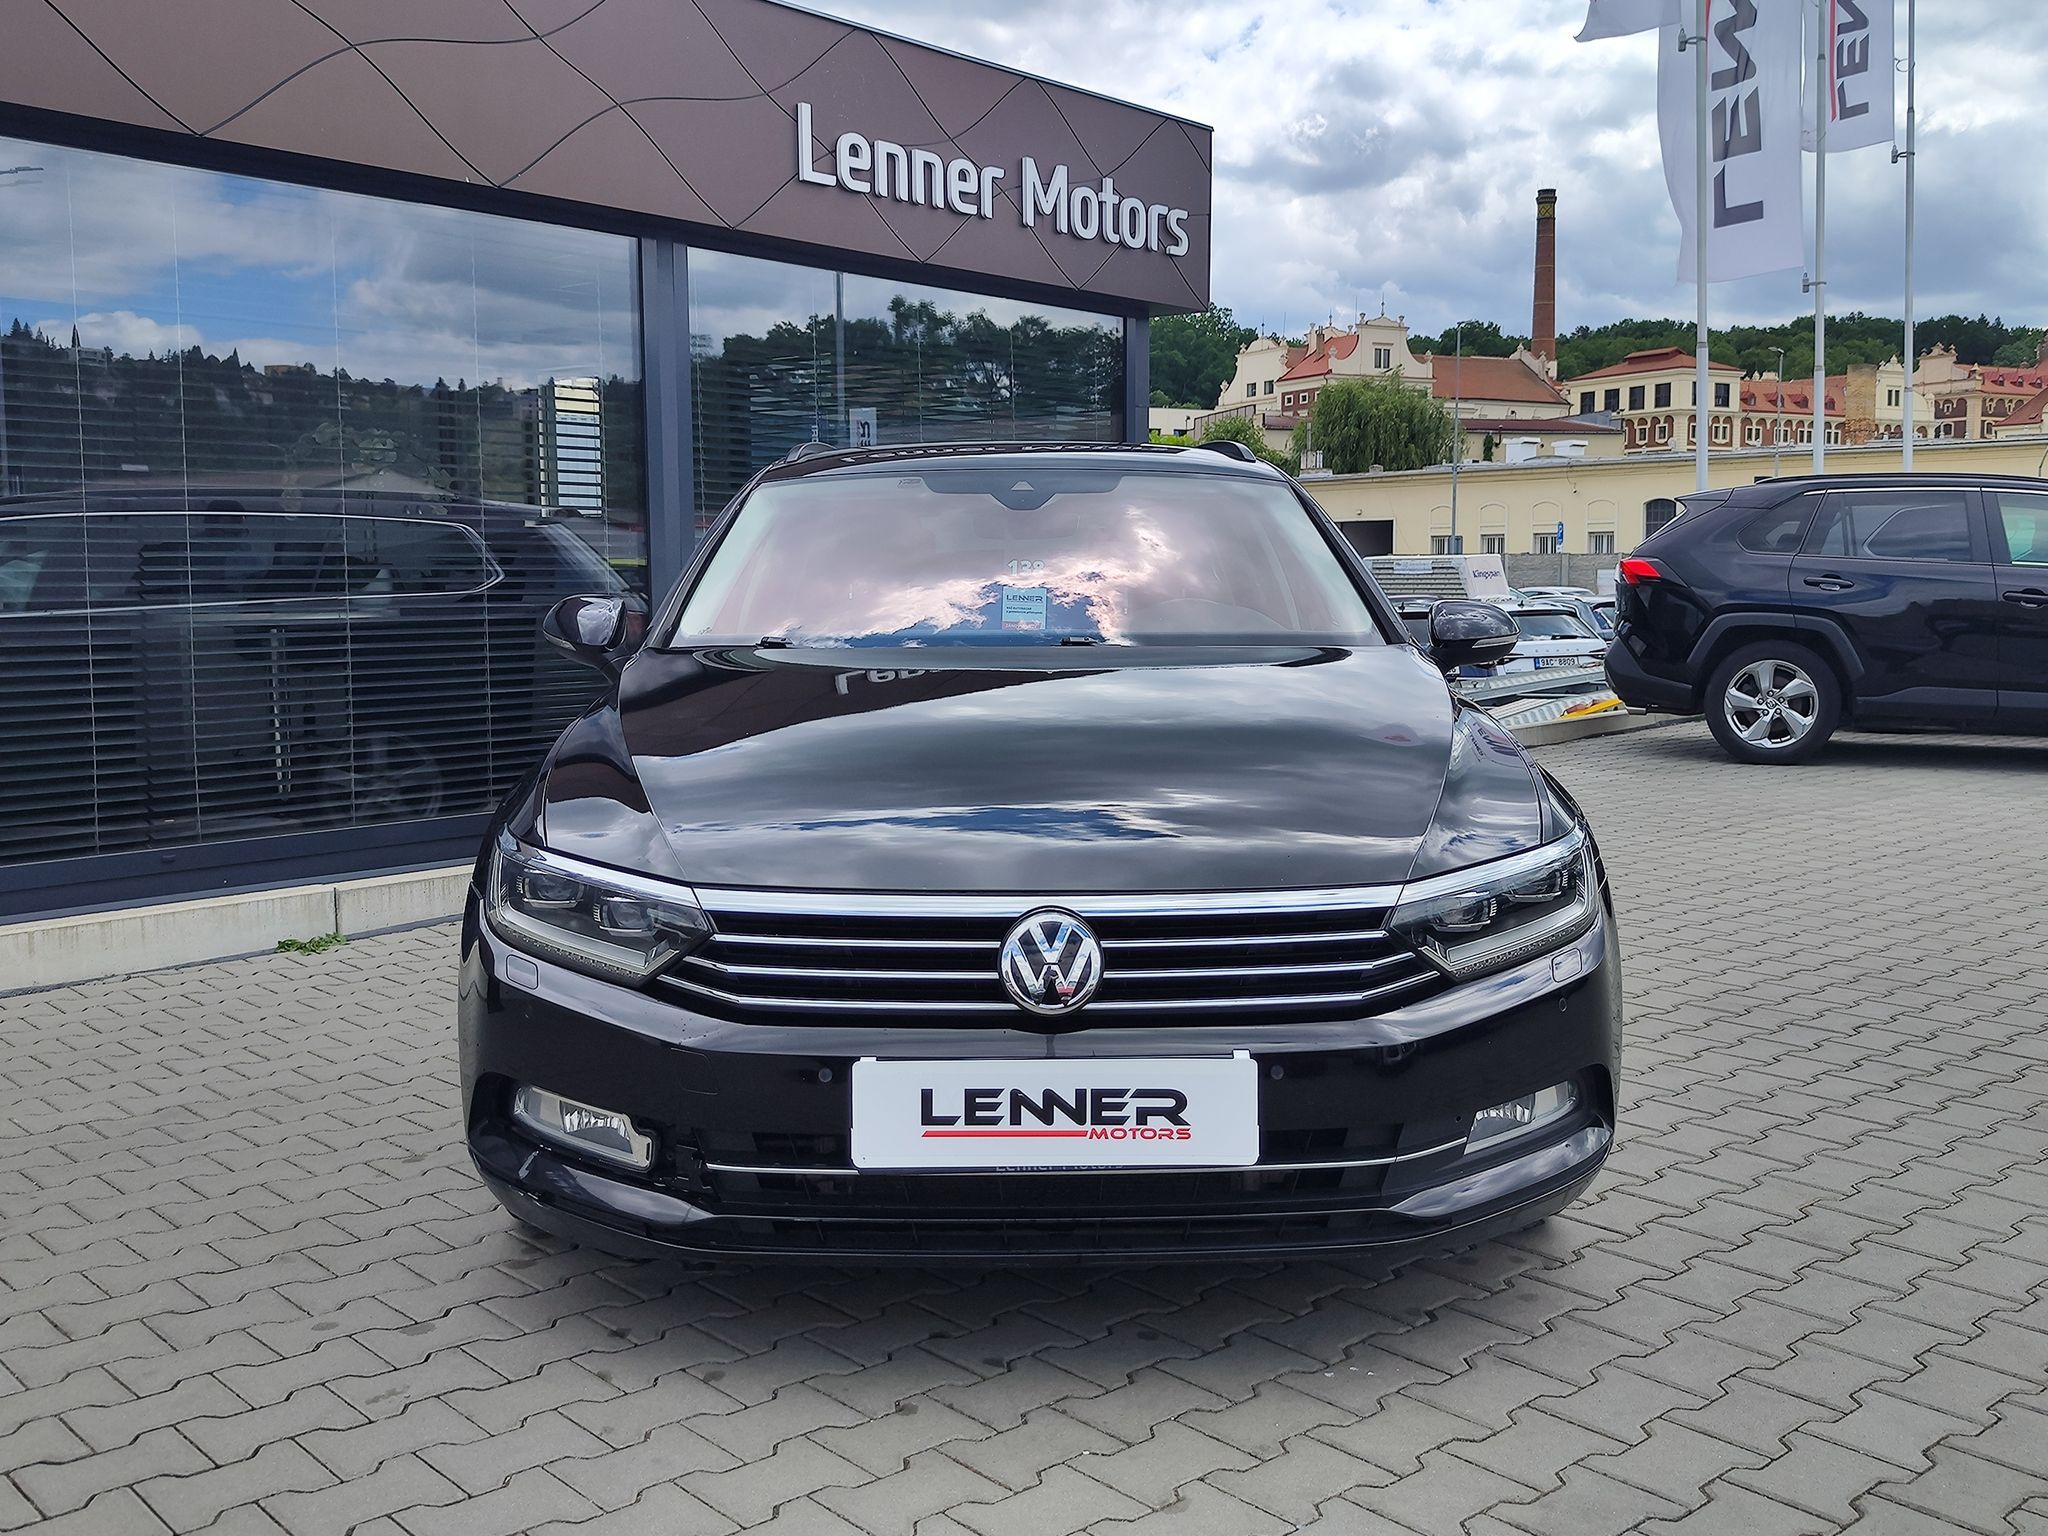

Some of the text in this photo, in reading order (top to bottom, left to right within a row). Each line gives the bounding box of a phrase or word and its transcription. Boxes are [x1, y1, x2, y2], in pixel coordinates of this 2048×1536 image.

[797, 102, 1190, 257] Lenner Motors
[1006, 594, 1043, 602] LENNER
[921, 1088, 1191, 1127] LENNER
[1088, 1127, 1191, 1140] MOTORS
